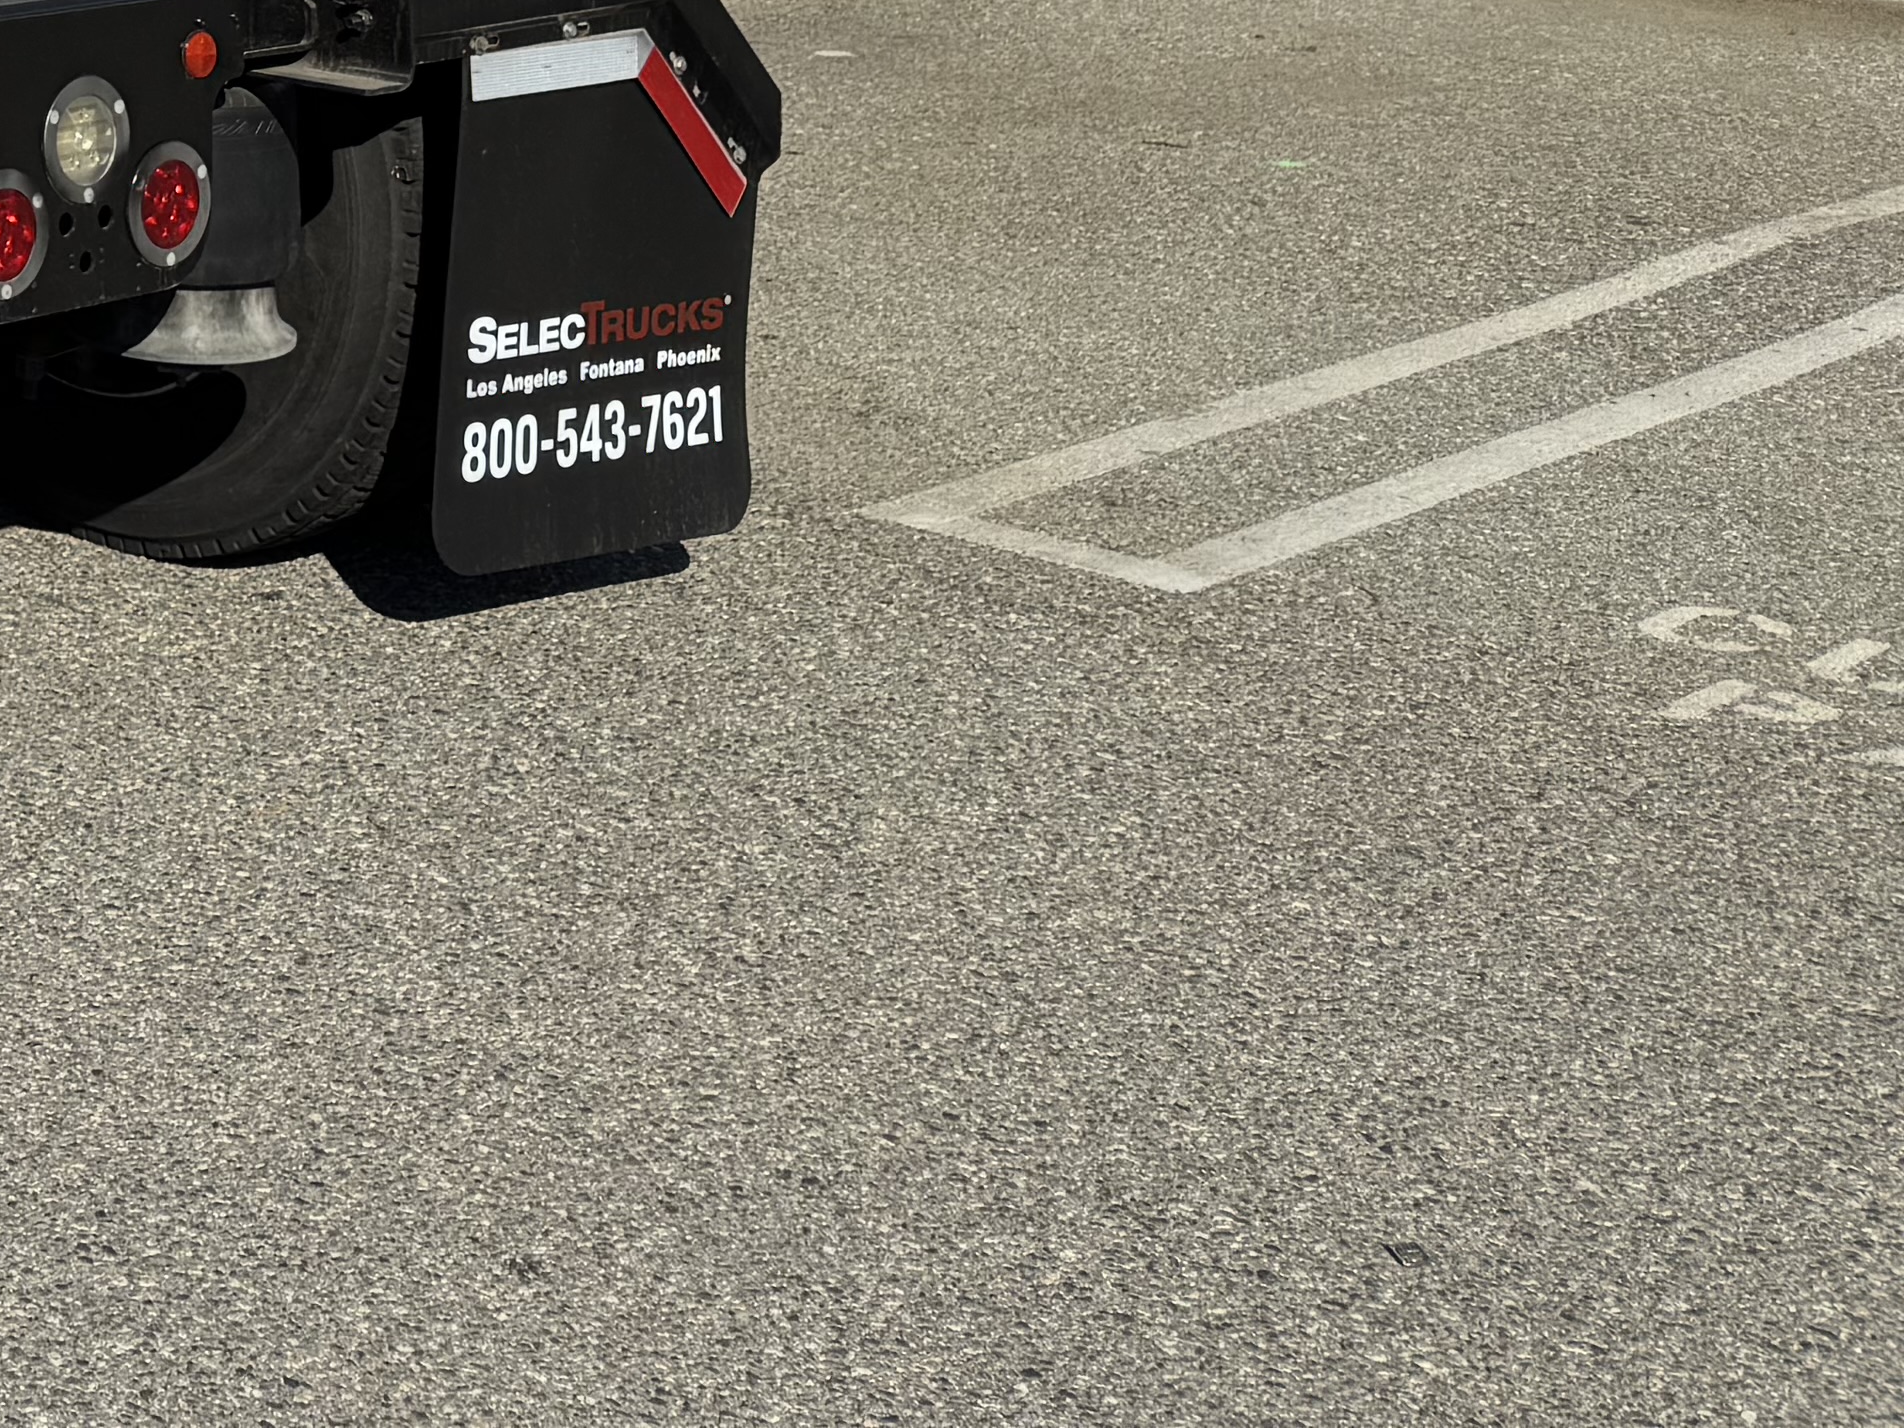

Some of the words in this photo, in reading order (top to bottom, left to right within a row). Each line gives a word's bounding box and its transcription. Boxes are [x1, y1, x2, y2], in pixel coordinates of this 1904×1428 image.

[466, 378, 498, 399] Los
[502, 367, 568, 395] Angeles
[580, 355, 645, 381] Fontana
[657, 343, 722, 370] Phoenix
[460, 385, 724, 484] 800-543-7621
